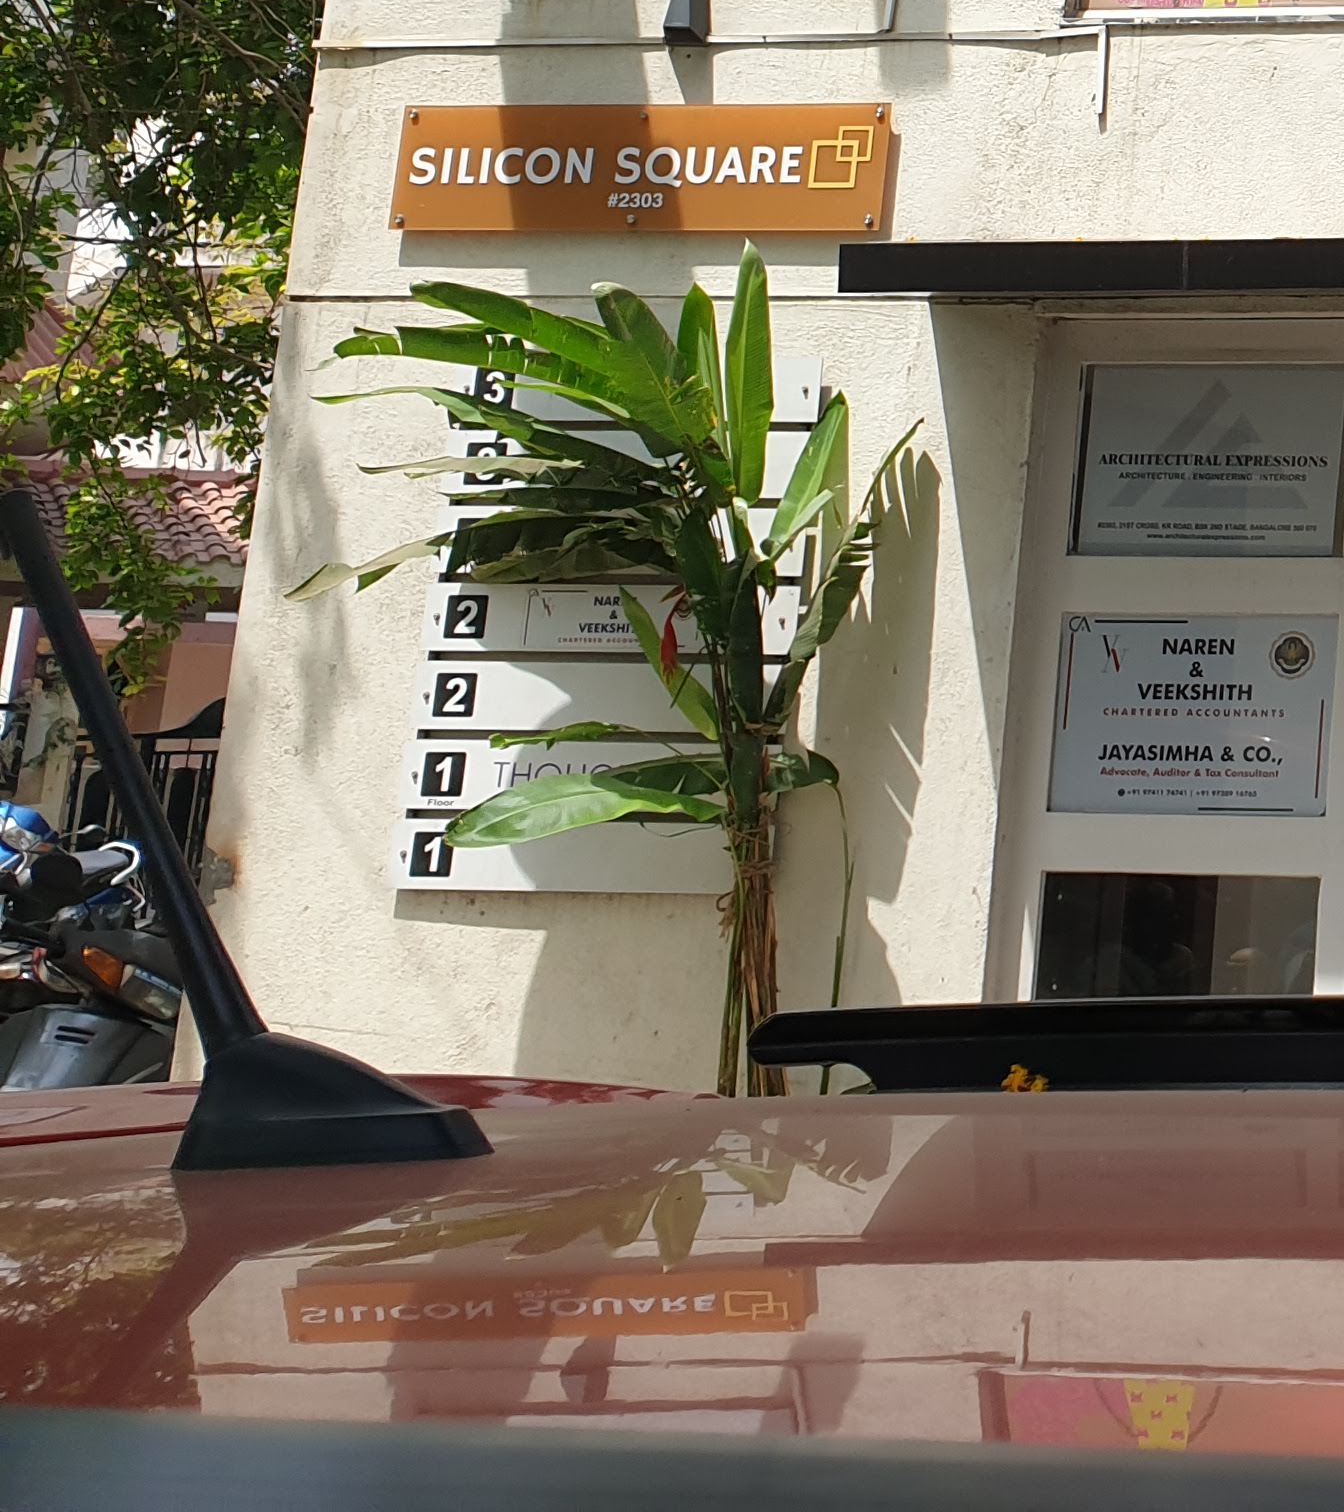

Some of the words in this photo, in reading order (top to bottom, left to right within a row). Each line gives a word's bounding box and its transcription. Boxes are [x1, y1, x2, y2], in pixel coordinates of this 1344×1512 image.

[408, 146, 595, 185] SILICON
[614, 144, 804, 188] SQUARE
[607, 192, 664, 209] #2303
[483, 370, 506, 405] 3
[1098, 453, 1222, 467] ARCHITECTURAL
[1225, 454, 1329, 468] EXPRESSIONS
[454, 599, 480, 633] 2
[609, 609, 618, 620] &
[1162, 638, 1235, 656] NAREN
[1188, 661, 1204, 678] &
[442, 679, 468, 713] 2
[1137, 683, 1253, 701] VEEKSHITH
[1102, 707, 1179, 717] CHARTERED
[1186, 707, 1285, 718] ACCOUNTANTS
[1098, 744, 1214, 762] JAYASIMHA
[1220, 745, 1235, 762] &
[435, 756, 453, 793] 1
[1100, 766, 1150, 778] Advocate,
[1153, 767, 1191, 778] Auditor
[1194, 767, 1202, 778] &
[1205, 768, 1222, 778] Tax
[1225, 768, 1280, 779] Consultant
[427, 798, 455, 807] Floor
[423, 838, 442, 873] 1
